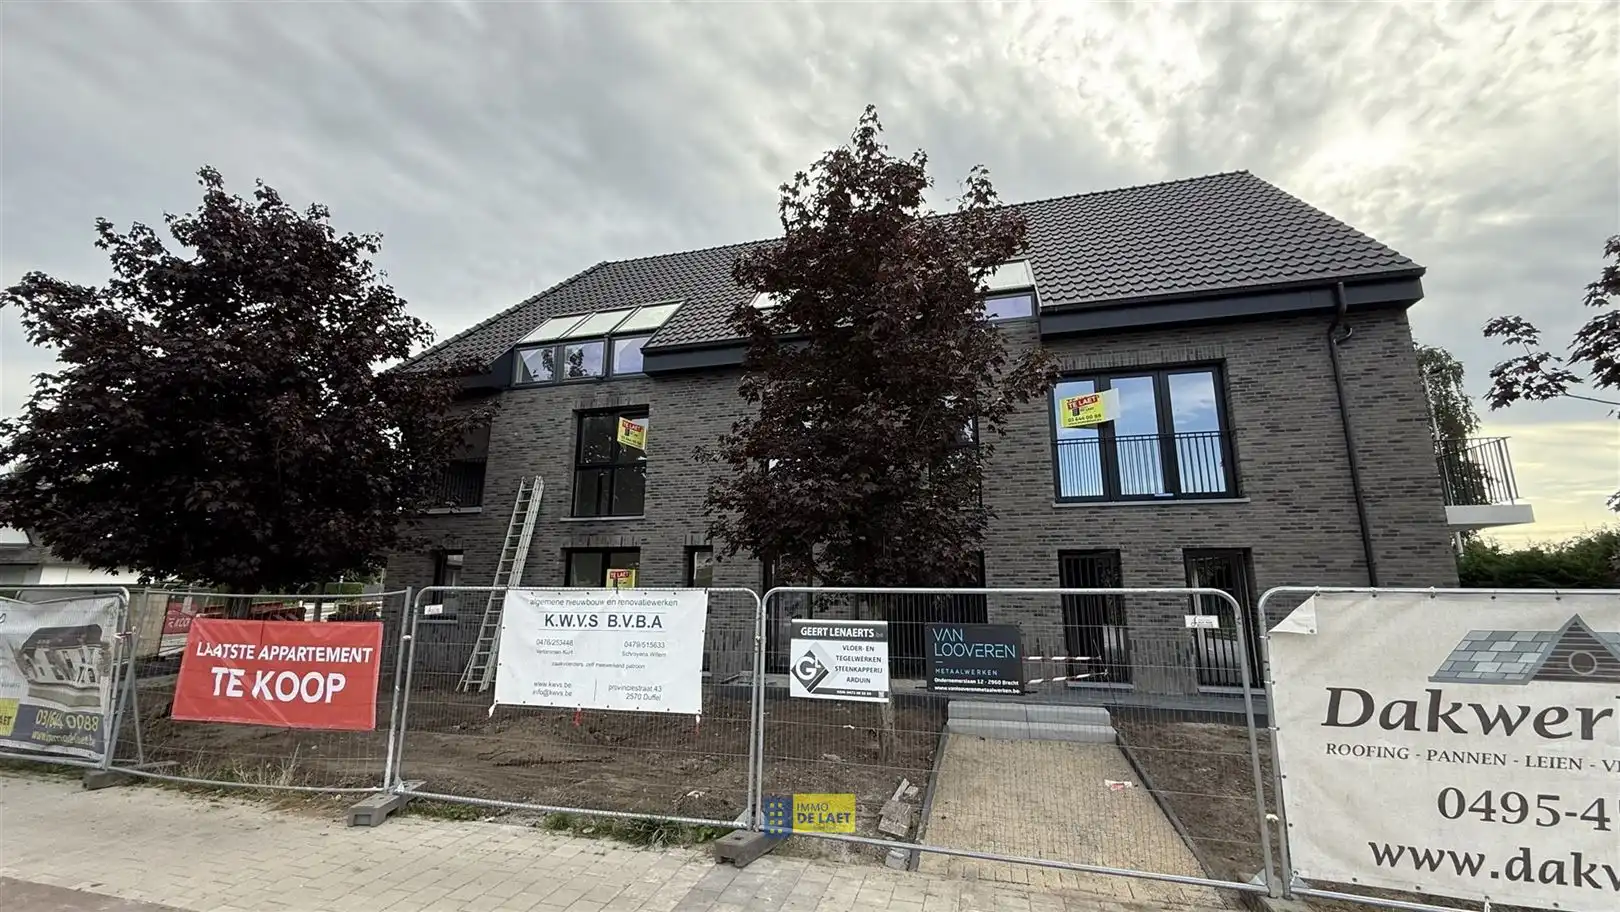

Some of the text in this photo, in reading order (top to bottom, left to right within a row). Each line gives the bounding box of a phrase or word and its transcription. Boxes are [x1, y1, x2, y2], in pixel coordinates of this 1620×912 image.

[530, 598, 564, 608] algemene
[566, 598, 604, 606] nieuwbouw
[617, 599, 678, 607] renovatiewerken
[545, 614, 662, 628] K.W.V.S B.V.B.A
[800, 626, 828, 636] GEERT
[932, 627, 963, 641] VAN
[196, 641, 373, 664] LAATSTE APPARTEMENT
[934, 642, 1016, 658] LOOVEREN
[835, 655, 881, 663] TEGELWERKEN
[835, 665, 882, 674] STEENKAPPERIJ
[935, 668, 998, 676] METAALWERKEN
[211, 666, 347, 704] TE KOOP
[608, 684, 652, 692] provinciestraat
[1320, 686, 1620, 742] Dakwer
[65, 714, 99, 732] 0088
[1325, 743, 1410, 760] ROOFING
[1426, 749, 1507, 767] PANNEN
[1525, 754, 1583, 771] LEIEN
[1437, 786, 1620, 833] 0495-4
